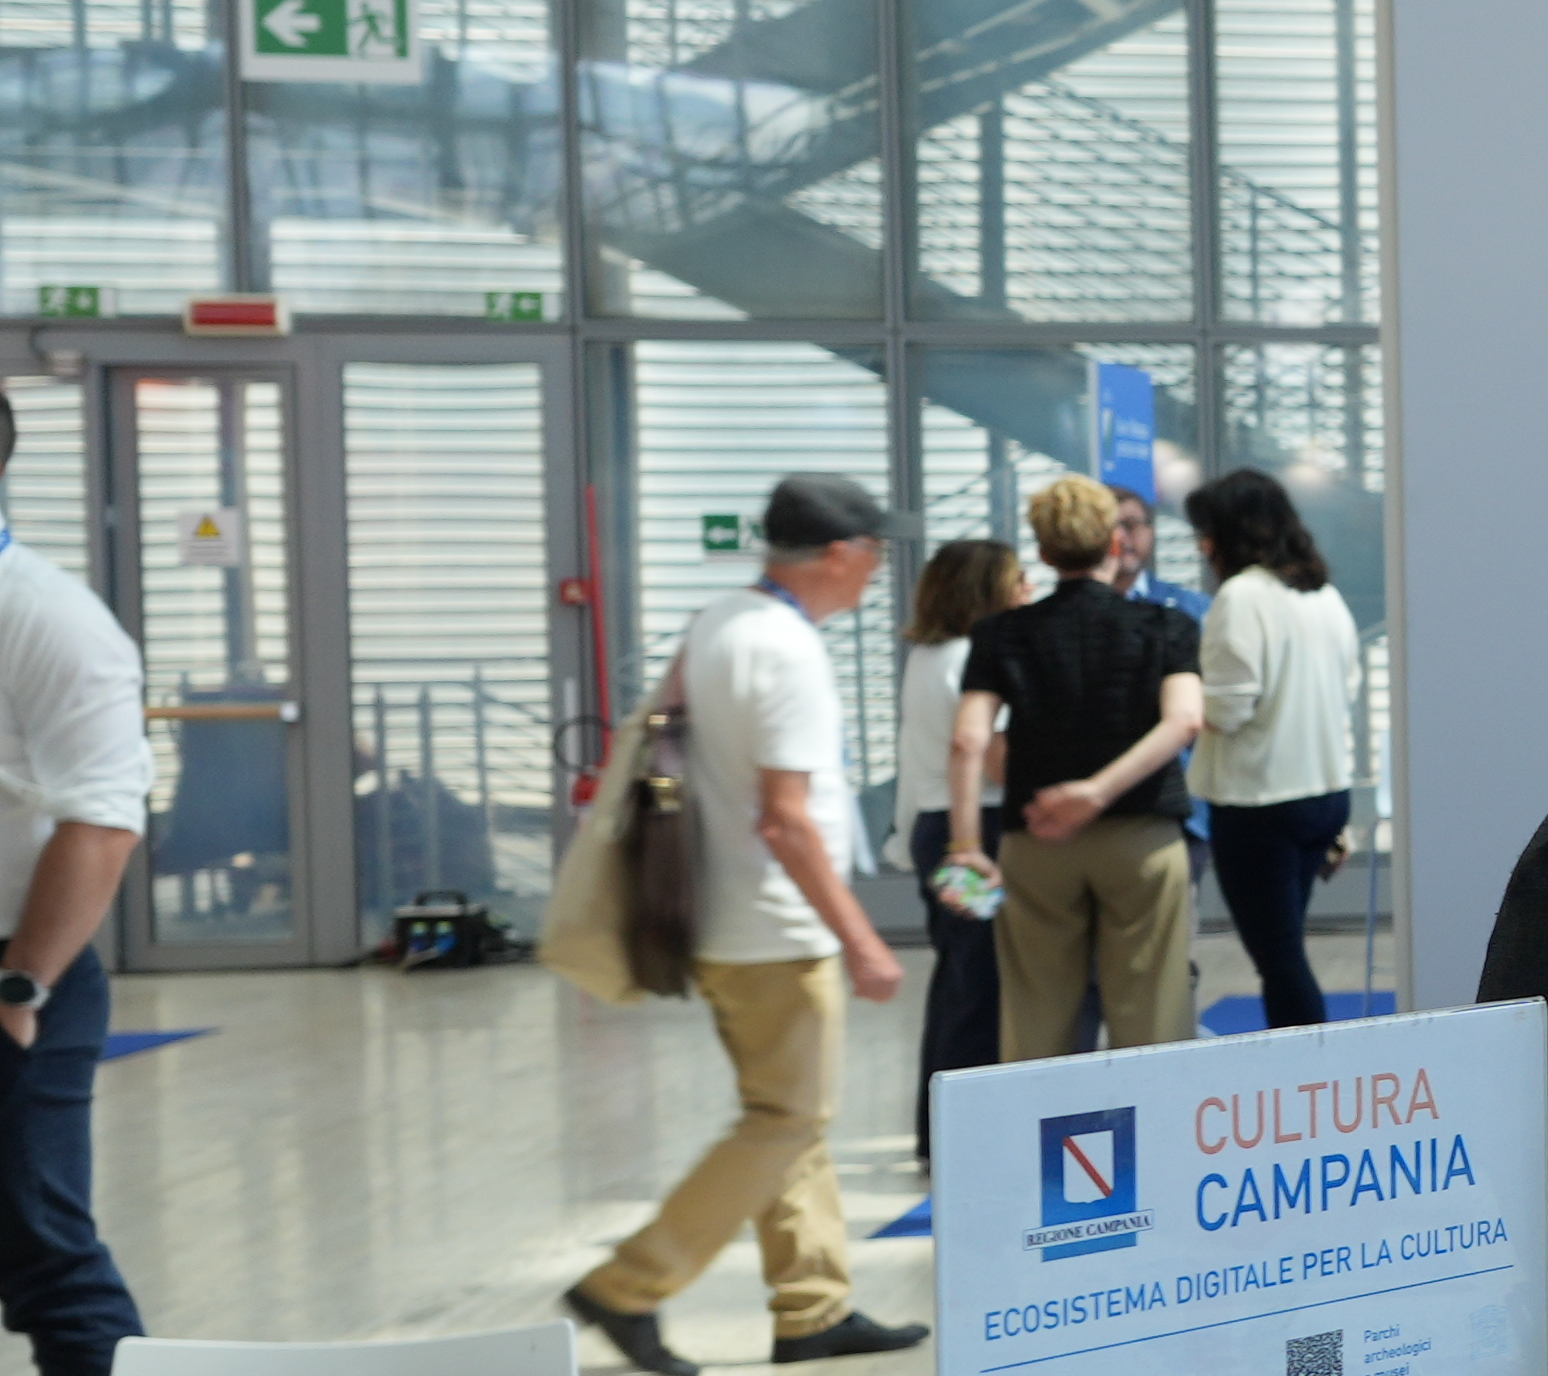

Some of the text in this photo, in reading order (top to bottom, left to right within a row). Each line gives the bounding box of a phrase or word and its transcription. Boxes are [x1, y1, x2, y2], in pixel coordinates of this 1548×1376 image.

[1194, 1067, 1441, 1154] CULTURA
[1195, 1133, 1476, 1231] CAMPANIA
[1026, 1214, 1152, 1248] REGIONE CAMPANIA
[984, 1217, 1509, 1342] ECOSISTEMA DIGITALE PER LA CULTURA
[1363, 1324, 1400, 1343] Parchi
[1363, 1337, 1432, 1365] archeologici
